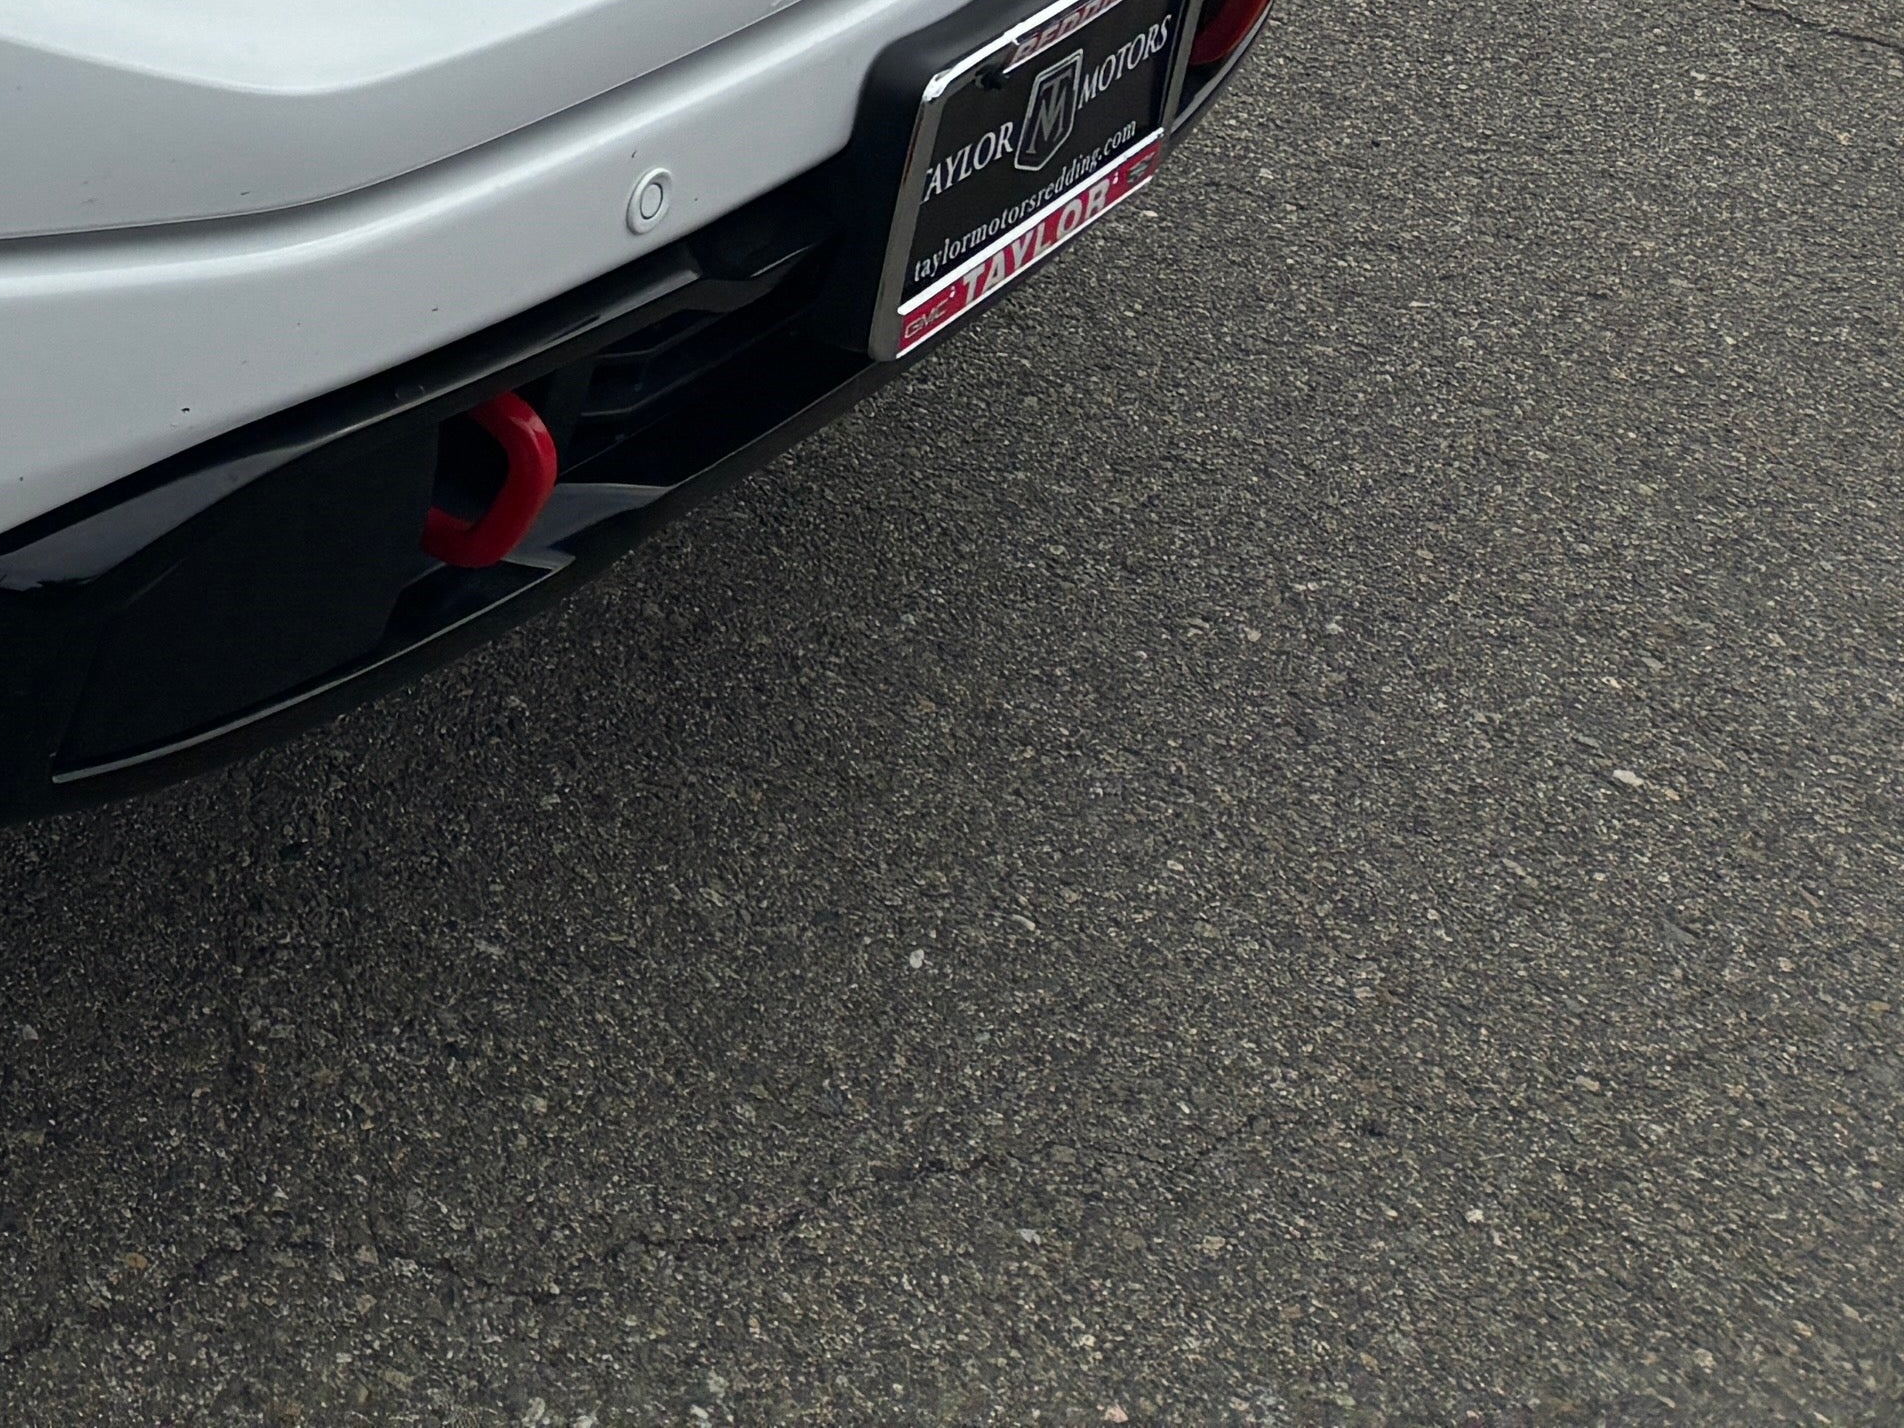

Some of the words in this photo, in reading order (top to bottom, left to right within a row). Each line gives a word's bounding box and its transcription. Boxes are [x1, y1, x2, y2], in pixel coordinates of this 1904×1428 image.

[1078, 14, 1172, 110] MOTORS
[914, 119, 1136, 282] taylormotorsredding.com
[963, 177, 1111, 307] TAYLOR
